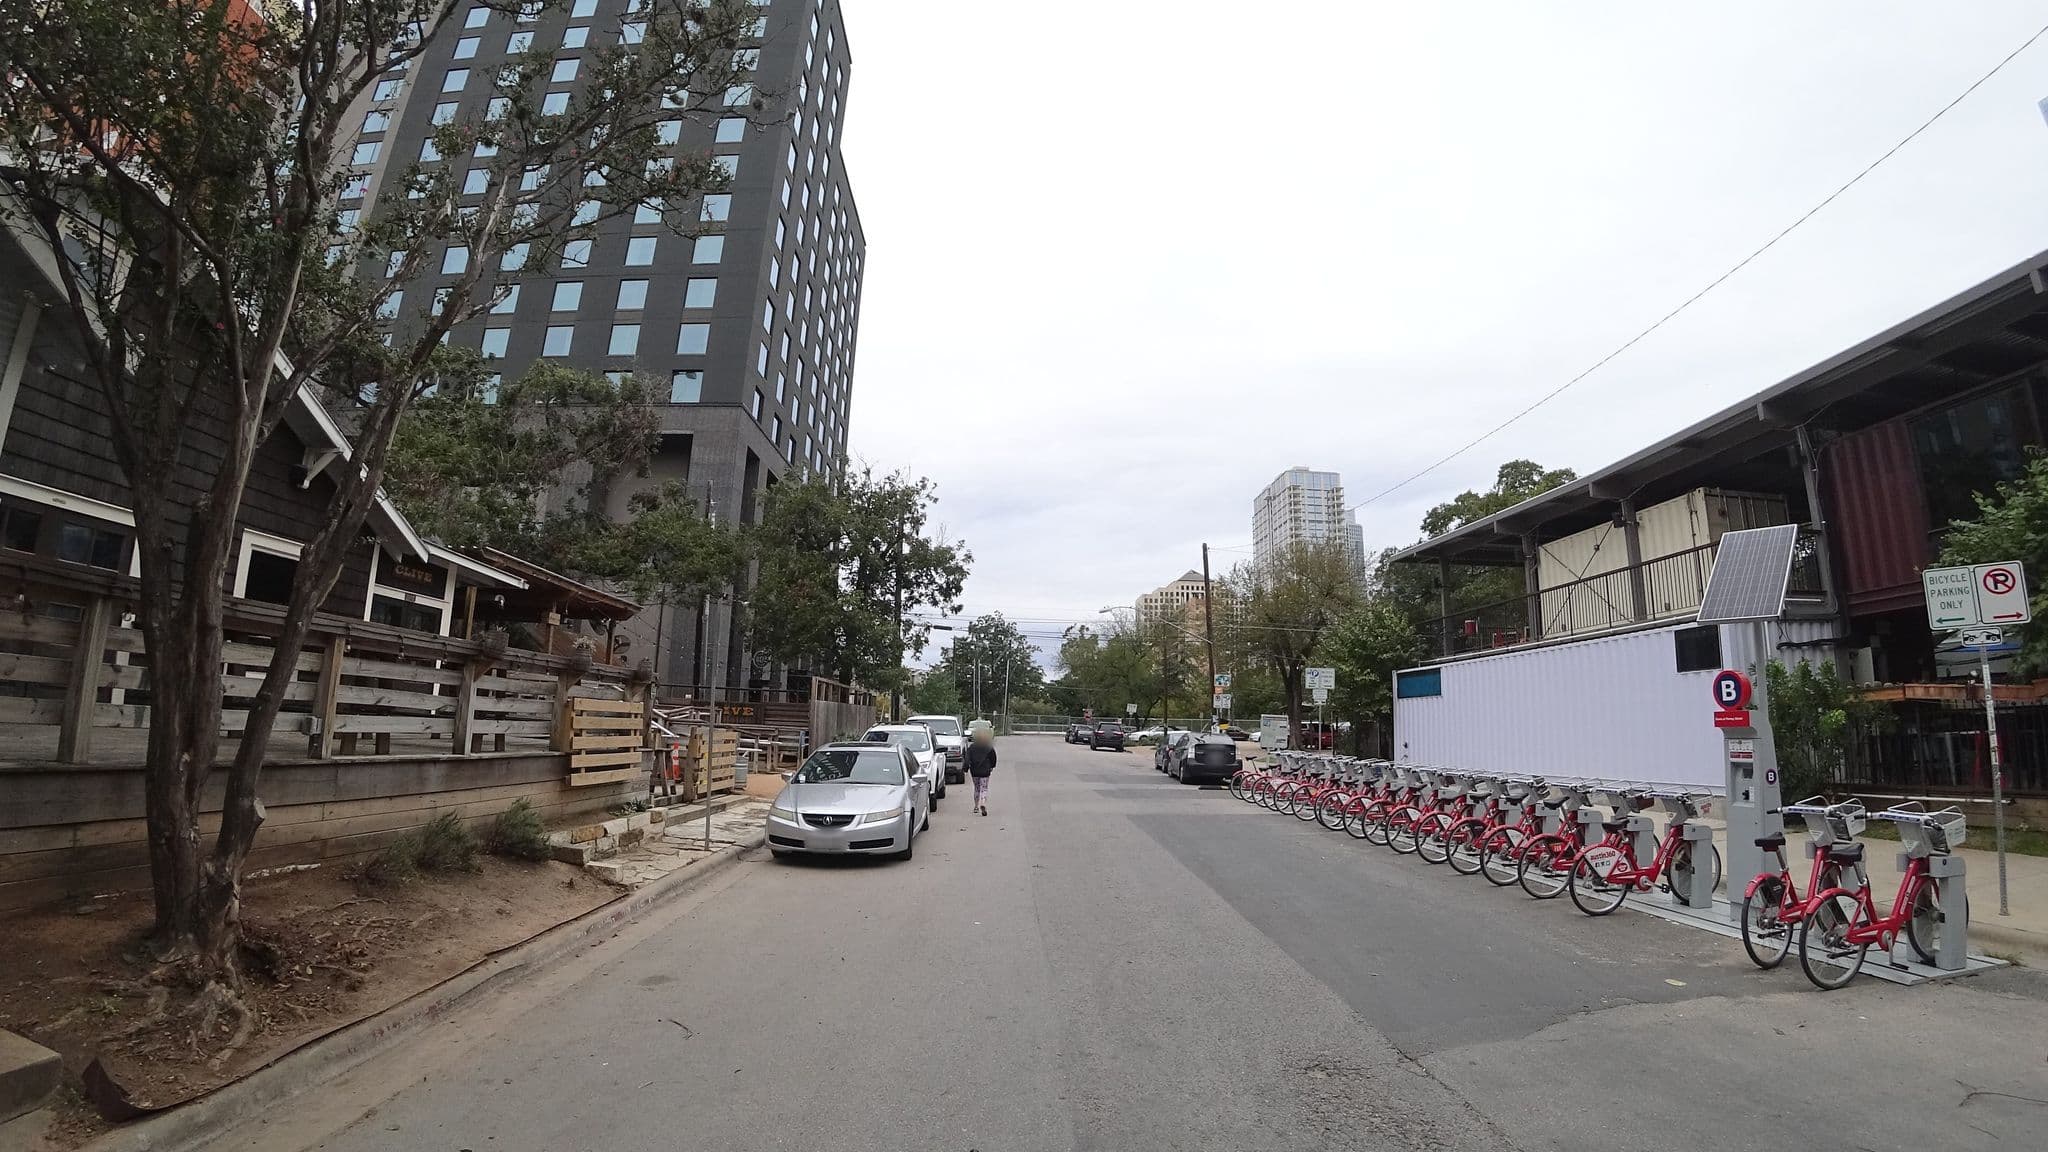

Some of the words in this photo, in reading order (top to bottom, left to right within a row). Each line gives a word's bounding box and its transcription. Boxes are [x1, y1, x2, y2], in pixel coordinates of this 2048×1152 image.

[1929, 574, 1967, 585] BICYCLE
[1930, 587, 1970, 598] PARKING
[1939, 600, 1963, 610] ONLY
[1721, 680, 1737, 702] B
[1768, 772, 1775, 781] B
